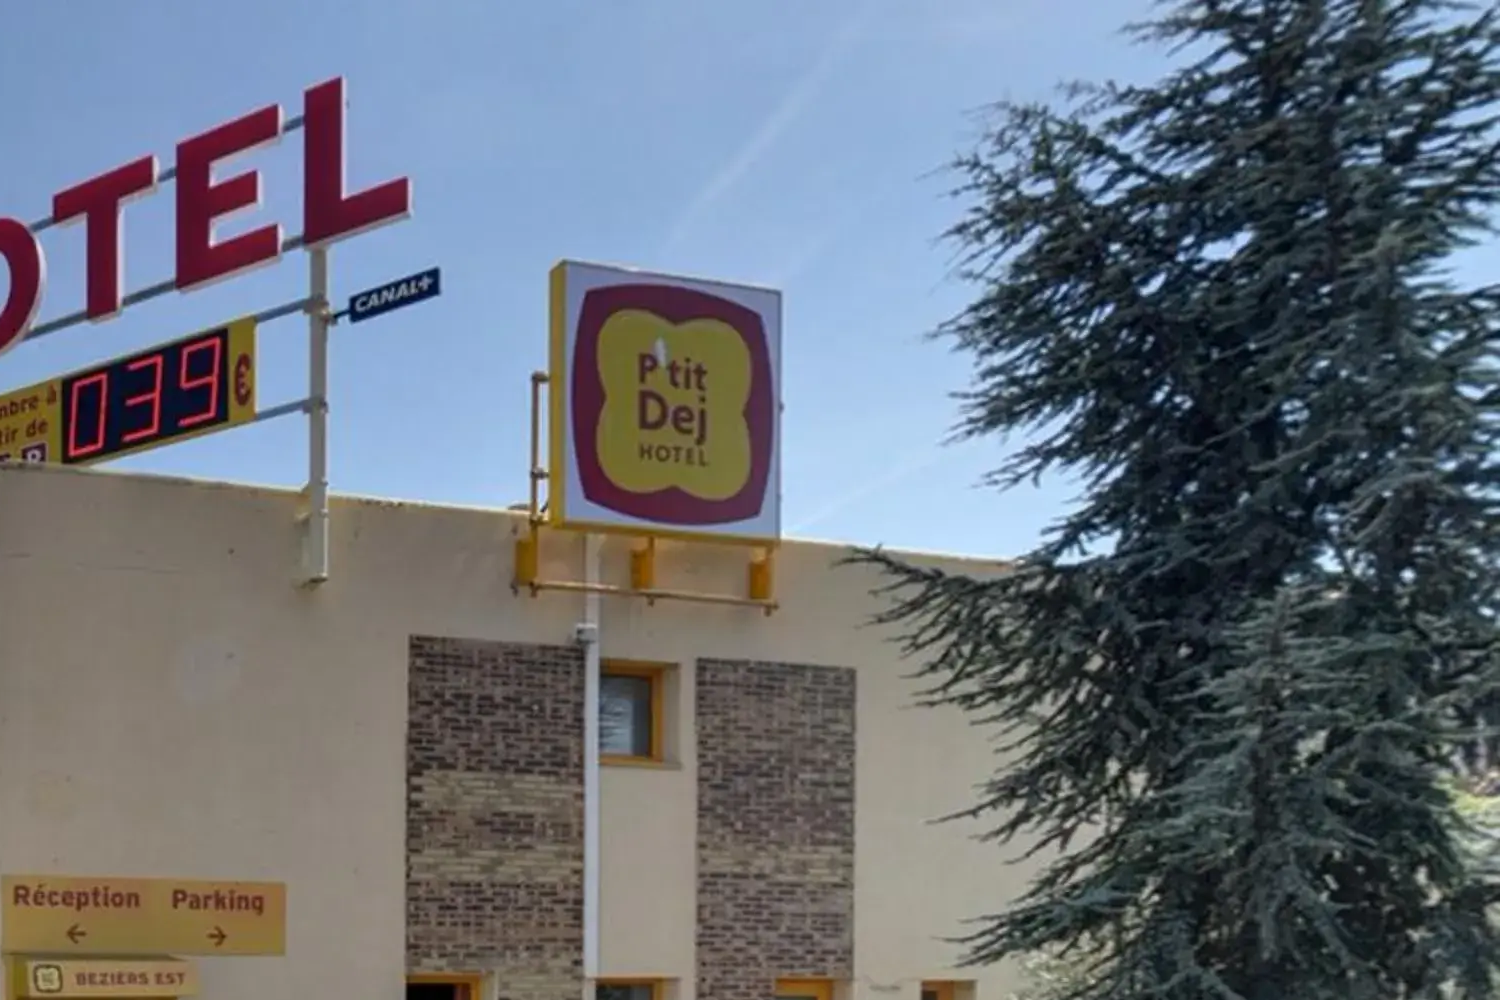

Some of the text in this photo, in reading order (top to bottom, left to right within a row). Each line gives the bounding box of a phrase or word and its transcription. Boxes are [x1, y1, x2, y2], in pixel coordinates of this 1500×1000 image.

[355, 275, 434, 314] CANAL+
[45, 384, 58, 407] à
[68, 336, 221, 458] 039
[233, 353, 251, 407] €
[25, 418, 49, 440] de
[638, 390, 707, 446] Dej
[639, 445, 710, 467] HOTEL
[12, 882, 265, 916] Réception Parking
[75, 971, 186, 987] BEZIERS EST
